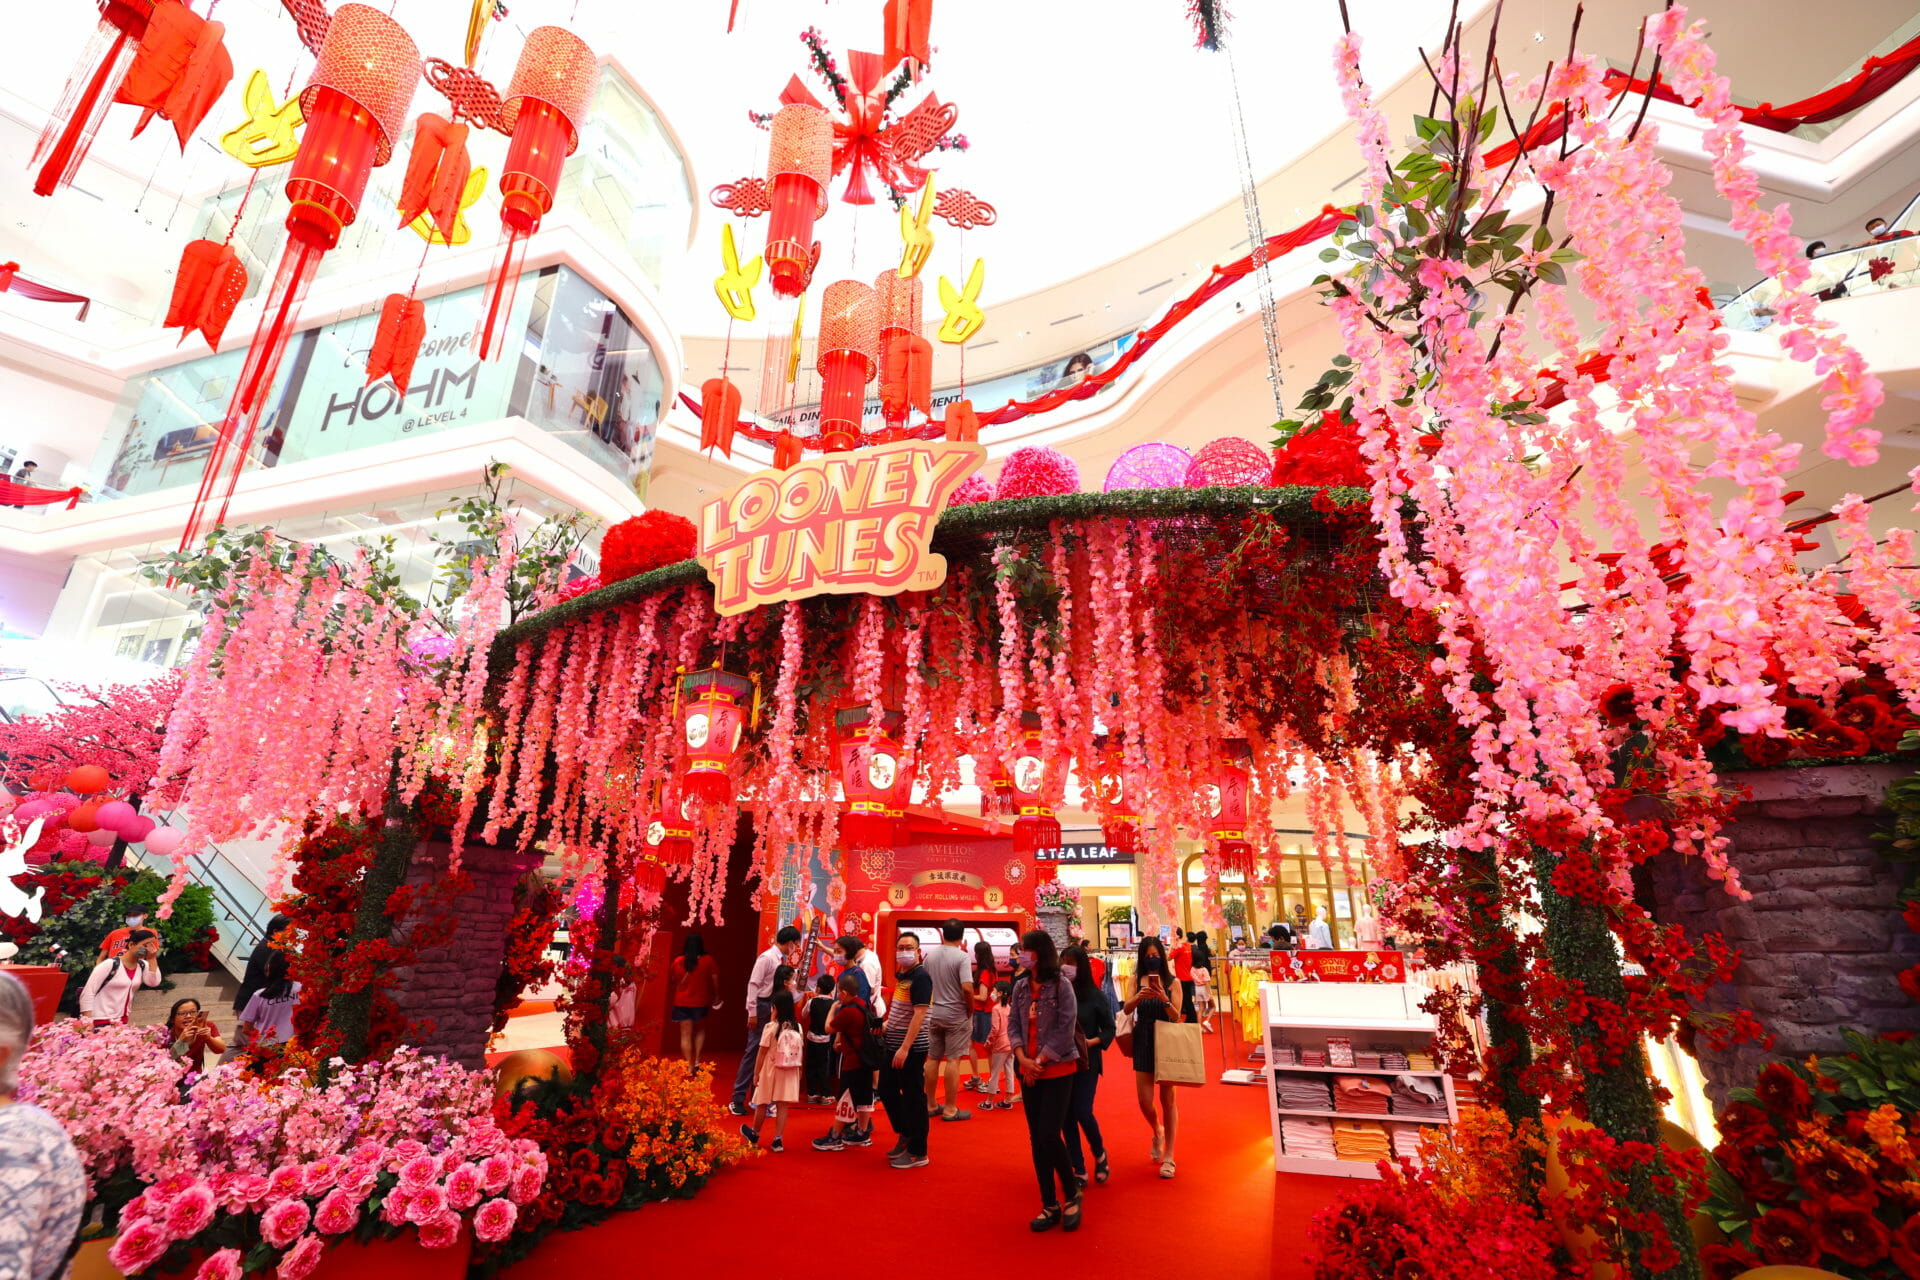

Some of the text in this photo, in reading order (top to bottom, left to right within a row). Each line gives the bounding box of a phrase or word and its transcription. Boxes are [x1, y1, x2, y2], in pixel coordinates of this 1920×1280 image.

[320, 360, 481, 431] HOHM
[417, 410, 457, 428] LEVEL
[460, 407, 468, 418] 4
[703, 449, 973, 553] LOONEY
[713, 512, 938, 604] TUNES TM
[920, 844, 976, 856] PAVILION
[1048, 847, 1076, 859] TEA
[1081, 846, 1118, 859] LEAF
[895, 889, 904, 899] 20
[989, 892, 998, 902] 23
